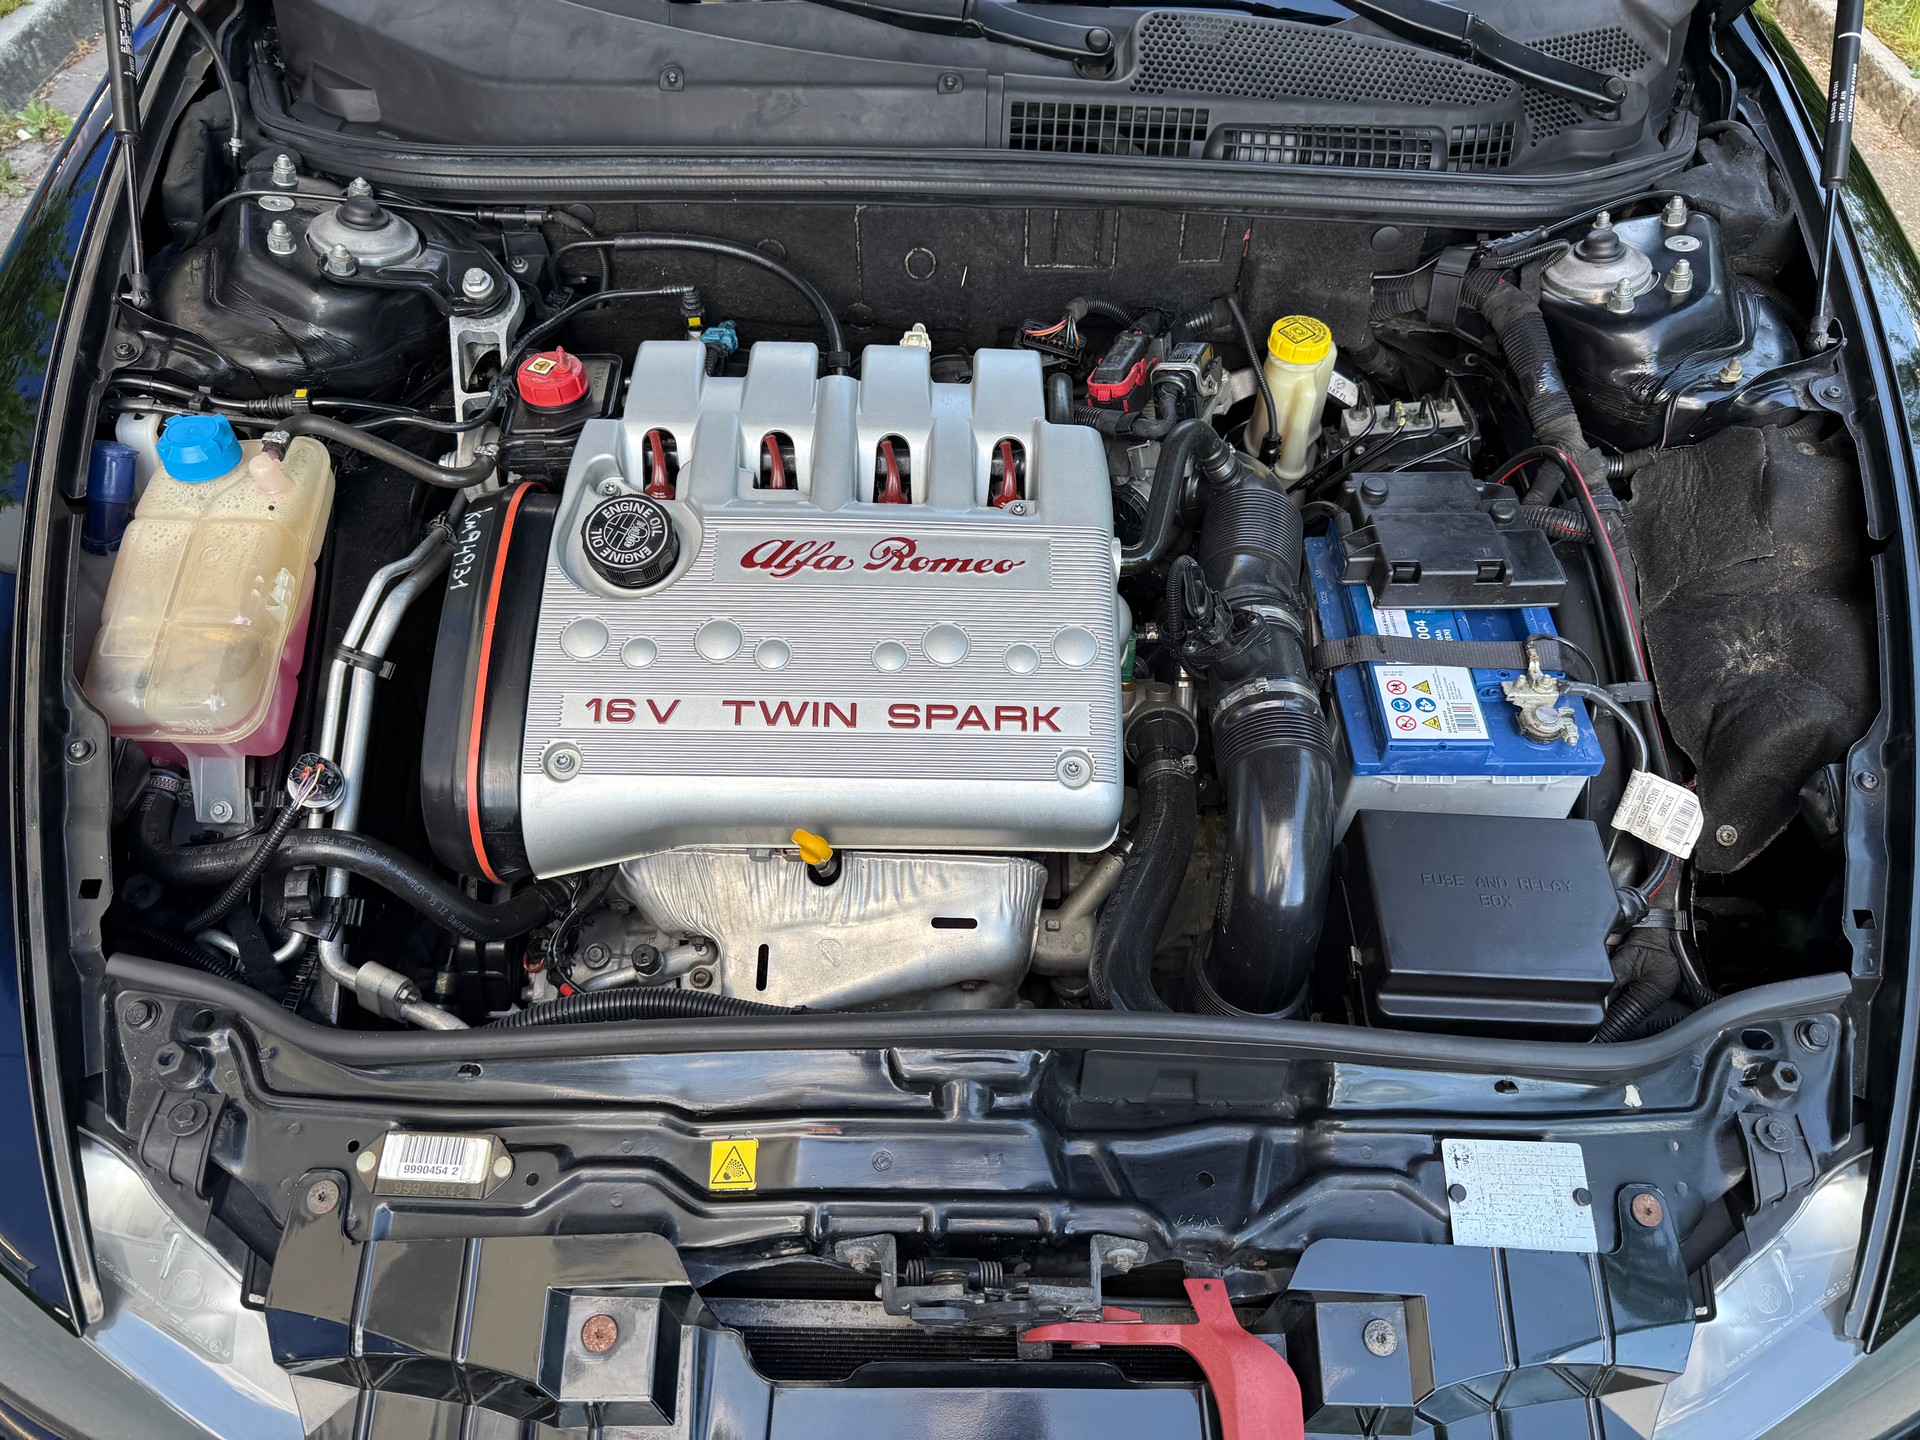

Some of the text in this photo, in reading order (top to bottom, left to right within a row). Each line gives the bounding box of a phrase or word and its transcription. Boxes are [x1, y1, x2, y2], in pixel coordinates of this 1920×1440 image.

[601, 502, 663, 537] ENGINE OIL
[591, 527, 604, 548] OIL
[600, 546, 653, 563] ENGINE
[740, 537, 1025, 579] Alfa Romeo
[1414, 620, 1431, 640] 004
[722, 700, 857, 729] TWIN
[888, 703, 1062, 733] SPARK
[1420, 873, 1573, 892] FUSE AND RELAY
[1479, 894, 1514, 907] BOX
[403, 1164, 448, 1176] 9990454
